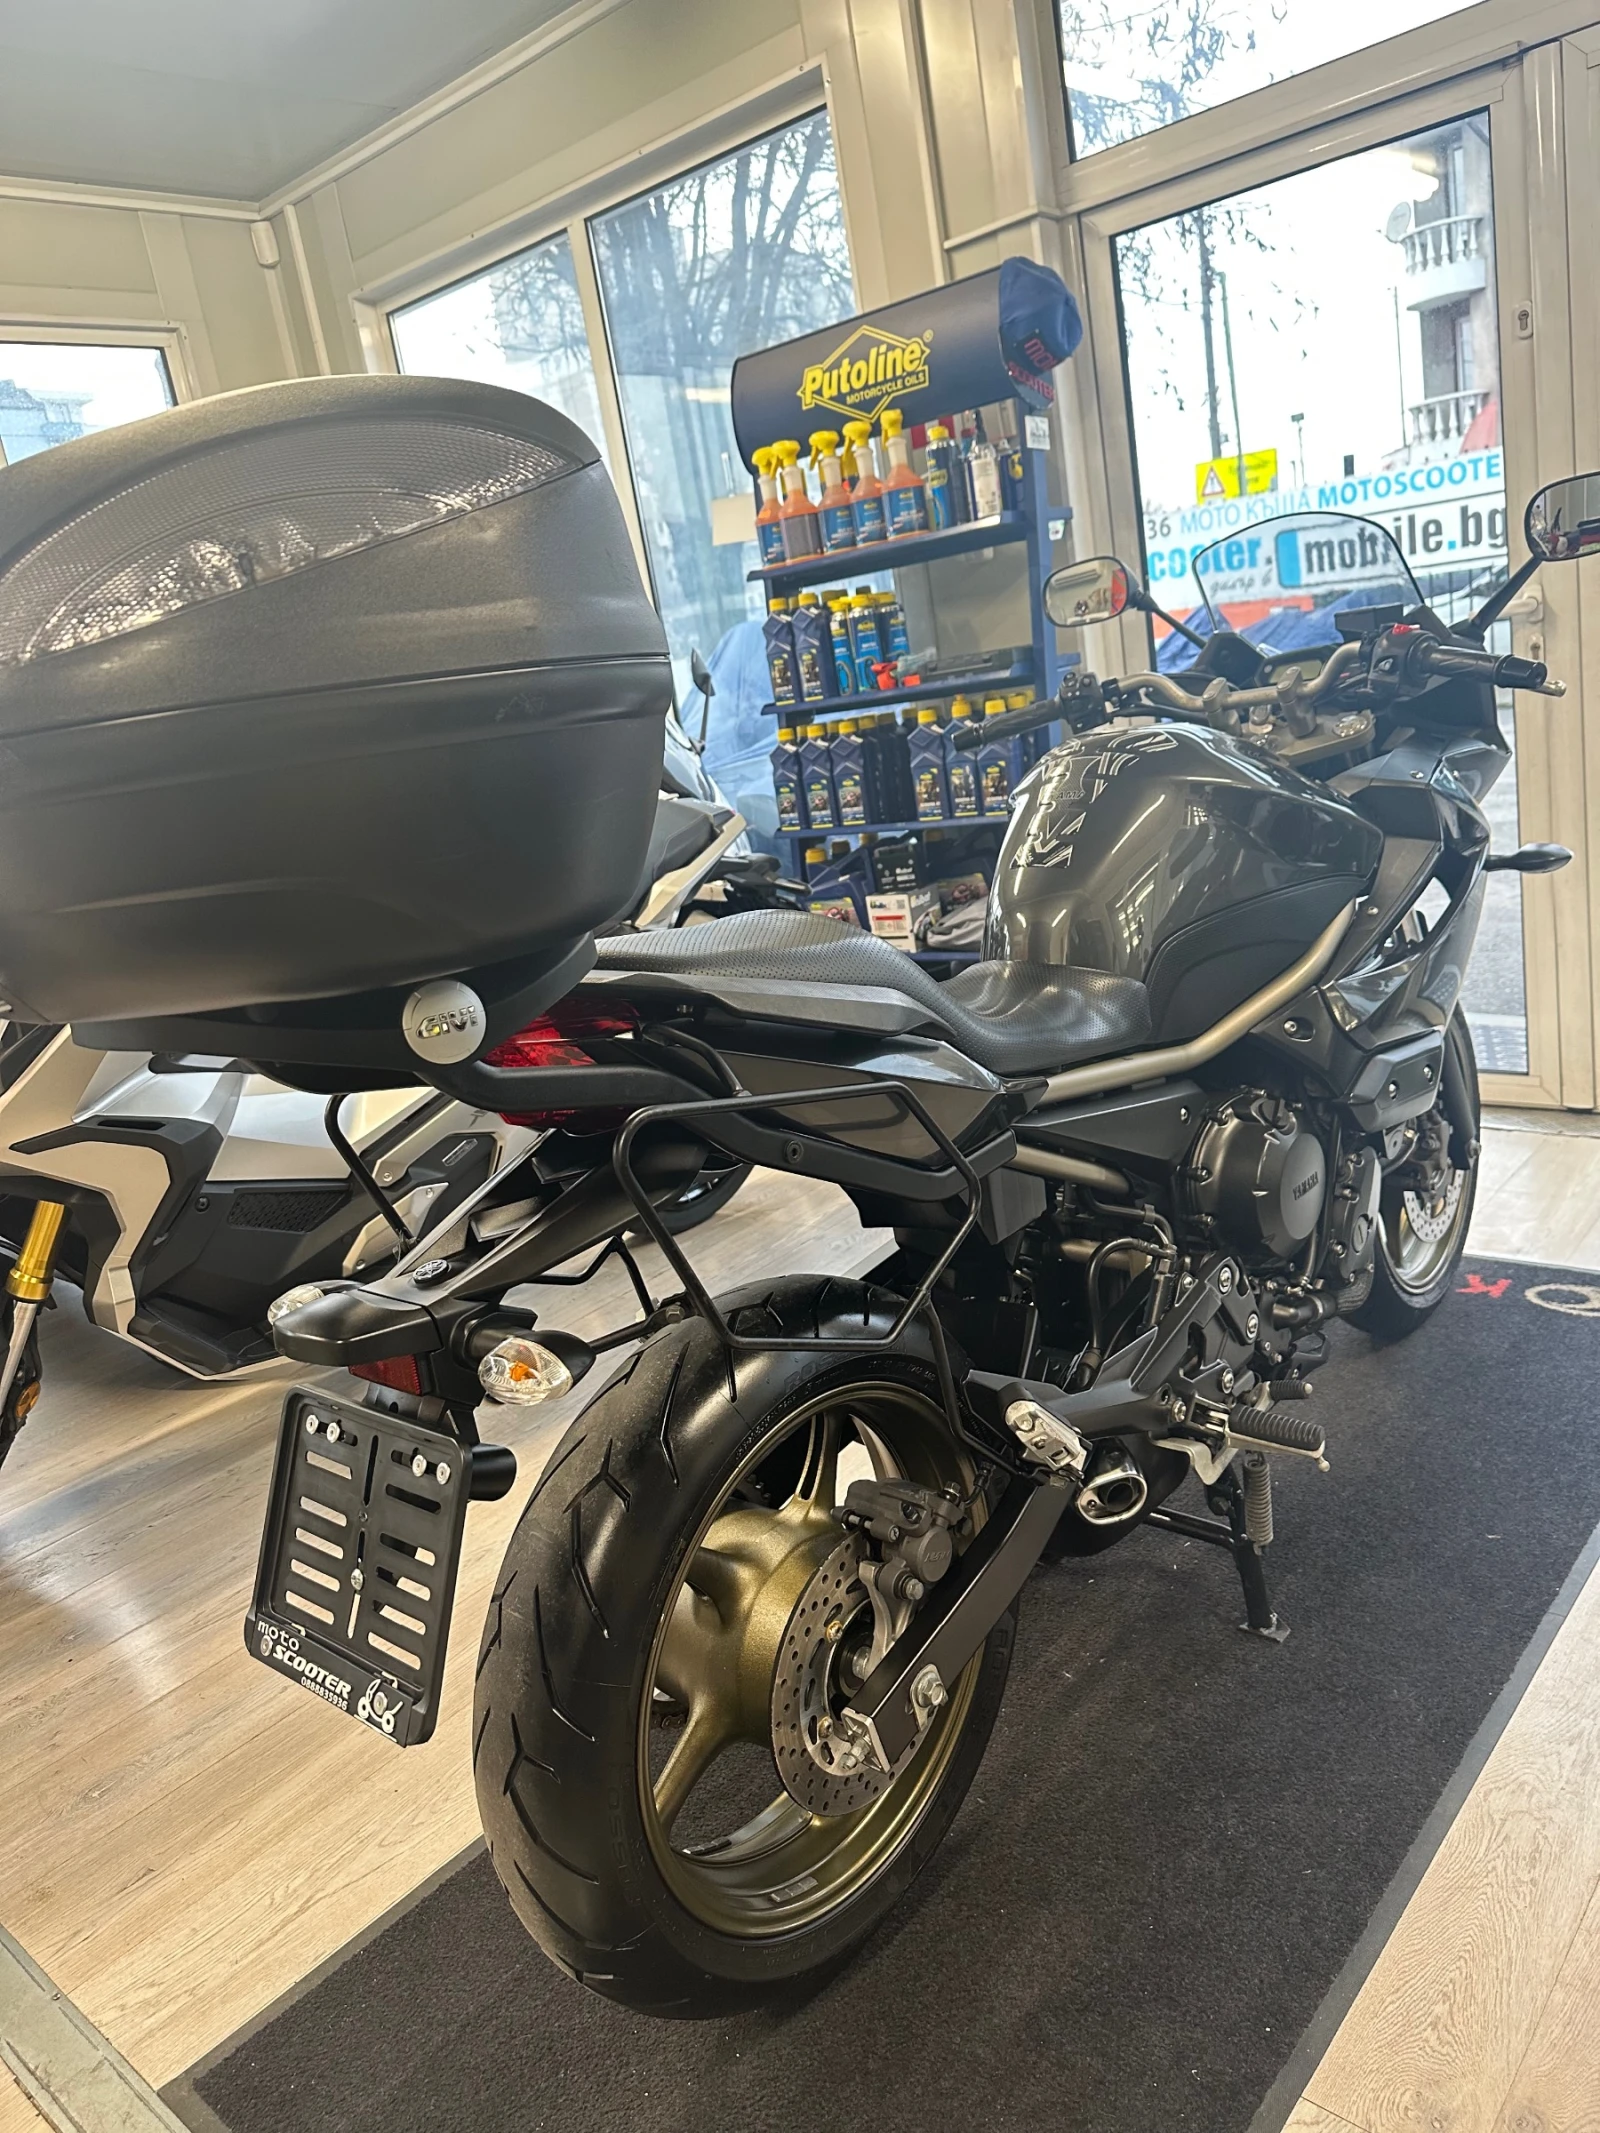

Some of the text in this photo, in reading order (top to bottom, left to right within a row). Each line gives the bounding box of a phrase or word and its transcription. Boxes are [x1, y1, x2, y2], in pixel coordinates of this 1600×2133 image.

[804, 342, 922, 406] Putoline
[845, 371, 925, 405] MOTORCYCLE OILS
[416, 1004, 479, 1040] GIVI
[1292, 1170, 1320, 1202] YAMAHA
[257, 1620, 300, 1652] moto
[272, 1644, 352, 1701] SCOOTER
[300, 1675, 349, 1712] 0888835936
